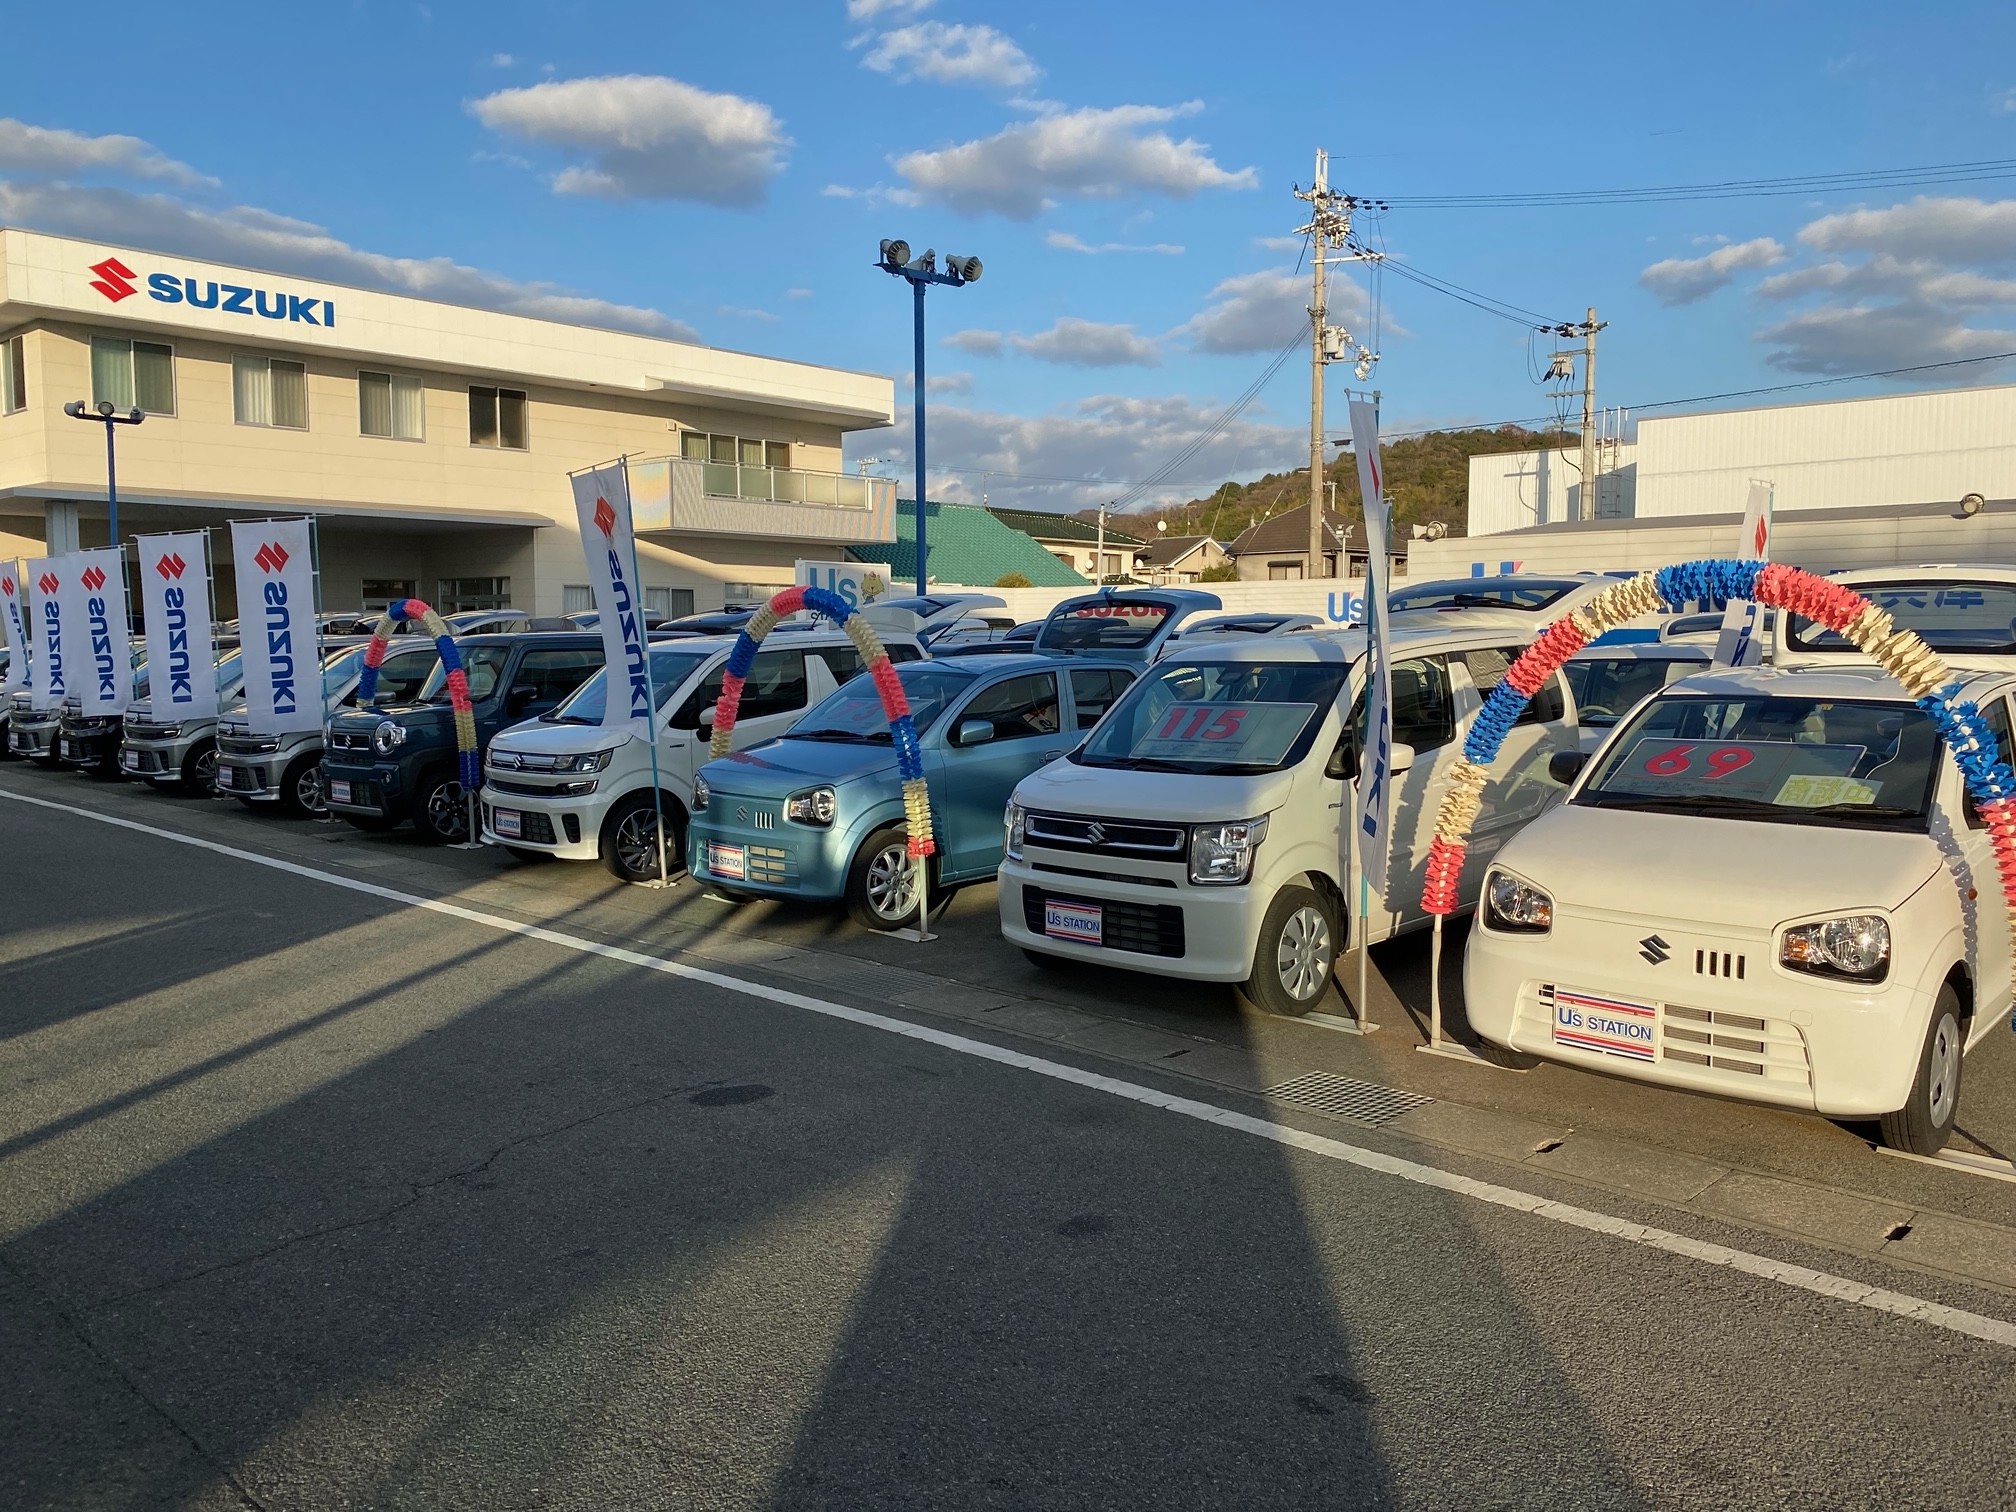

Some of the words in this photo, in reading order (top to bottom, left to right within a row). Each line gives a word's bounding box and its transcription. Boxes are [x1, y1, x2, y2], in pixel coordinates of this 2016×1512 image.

[147, 272, 335, 328] SUZUKI
[1076, 605, 1167, 618] SUZUK
[1157, 707, 1249, 740] 115
[1643, 744, 1756, 779] 69
[1063, 916, 1100, 931] STATION
[1587, 1016, 1652, 1041] STATION
